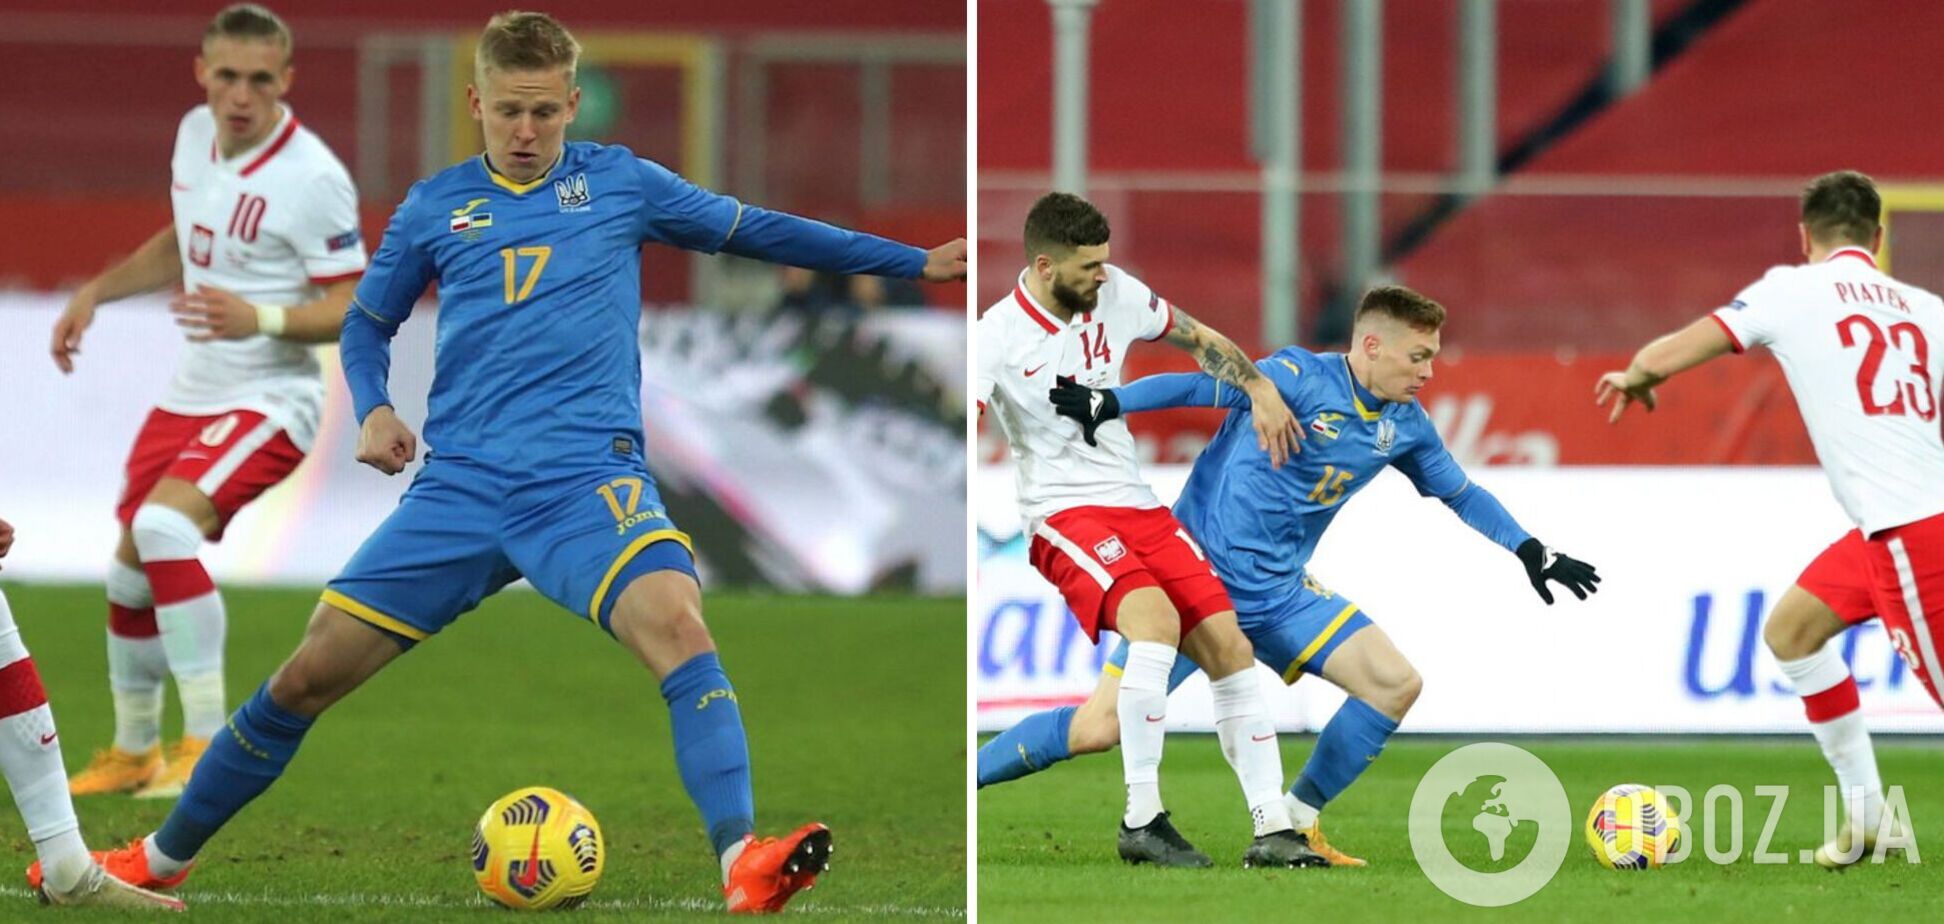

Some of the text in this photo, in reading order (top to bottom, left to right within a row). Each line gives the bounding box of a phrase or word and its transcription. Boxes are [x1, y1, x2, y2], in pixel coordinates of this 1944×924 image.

[227, 193, 267, 244] 10
[501, 246, 553, 305] 17
[1079, 322, 1111, 371] 14
[1835, 314, 1937, 423] 23
[596, 478, 643, 523] 17
[1307, 464, 1354, 507] 15
